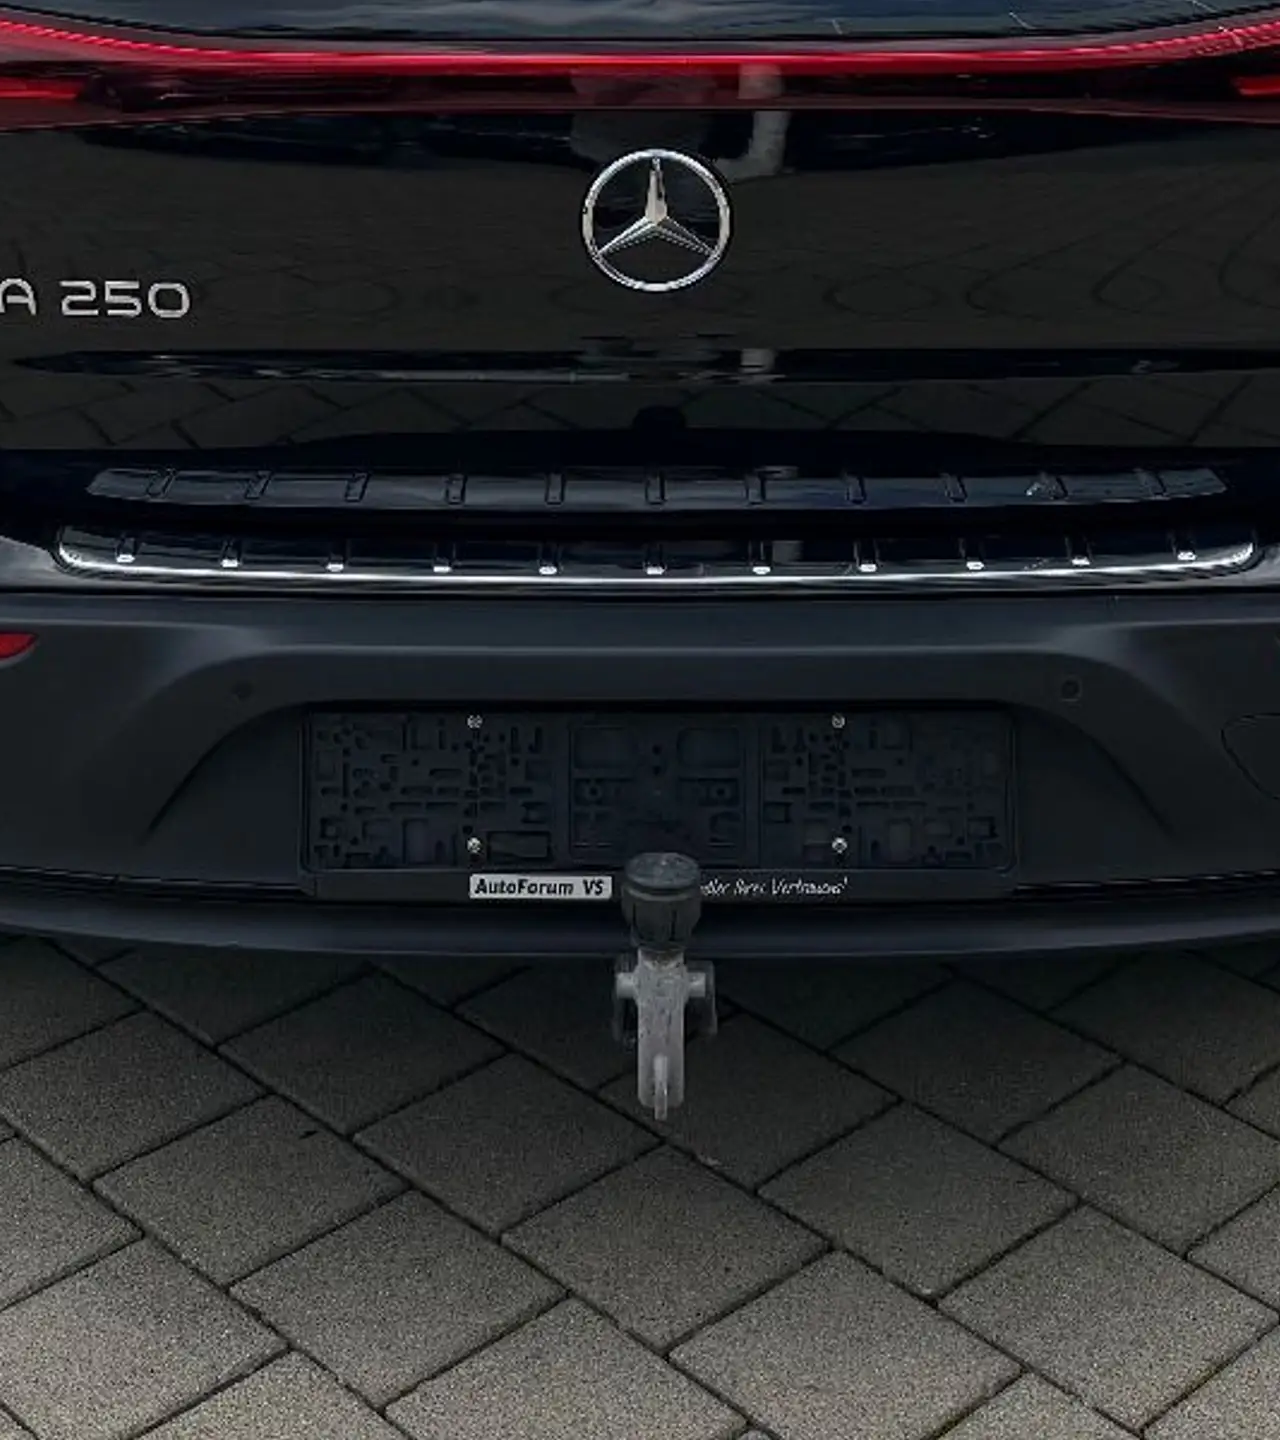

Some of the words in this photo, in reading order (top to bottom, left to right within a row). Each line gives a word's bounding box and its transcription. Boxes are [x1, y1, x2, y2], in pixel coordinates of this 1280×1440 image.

[58, 279, 191, 319] 250
[474, 878, 574, 896] AutoForum
[582, 878, 605, 896] VS
